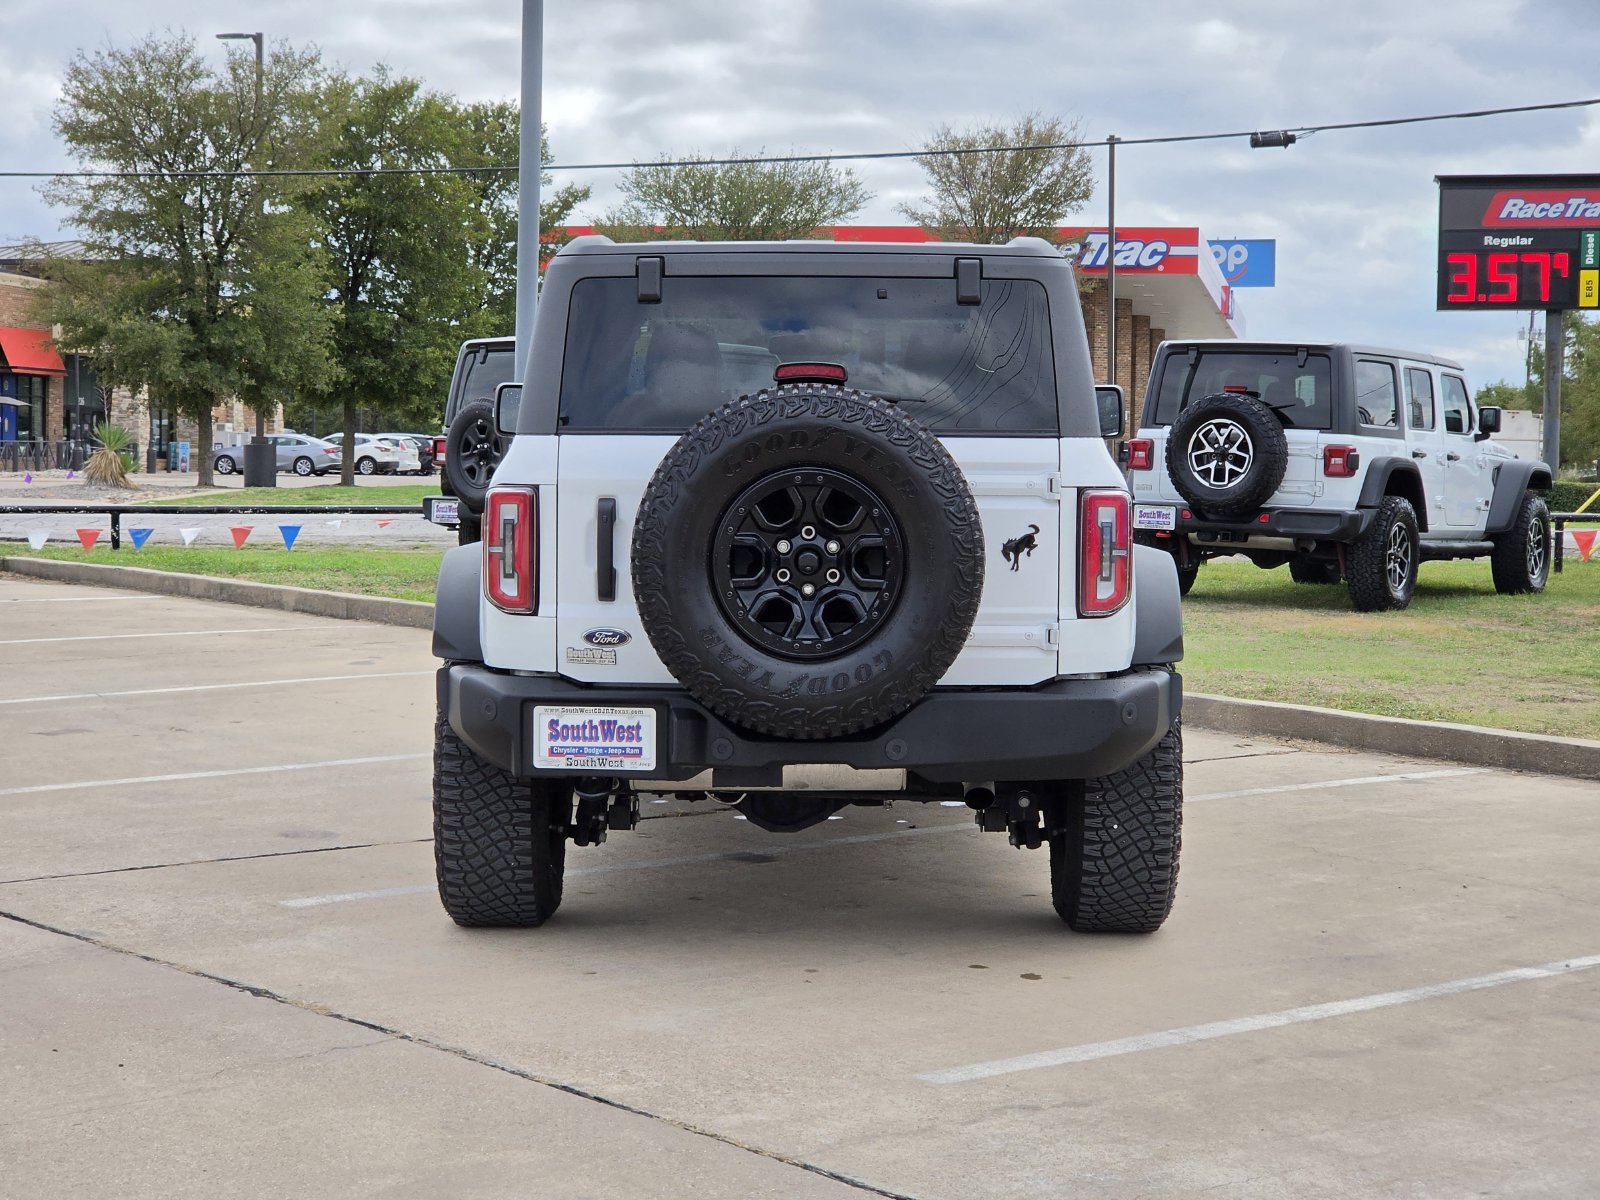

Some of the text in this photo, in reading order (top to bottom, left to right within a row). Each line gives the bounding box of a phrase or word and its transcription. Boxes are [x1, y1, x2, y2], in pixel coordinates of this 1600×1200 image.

[1483, 235, 1534, 248] Regular
[1585, 233, 1595, 265] Diesel
[1585, 279, 1594, 298] E85
[1138, 510, 1171, 520] SouthWest
[593, 631, 620, 644] Ford
[548, 718, 643, 742] SouthWest
[553, 746, 640, 756] Chrysler Dodge Jeep Ram
[566, 757, 624, 768] SouthWest
